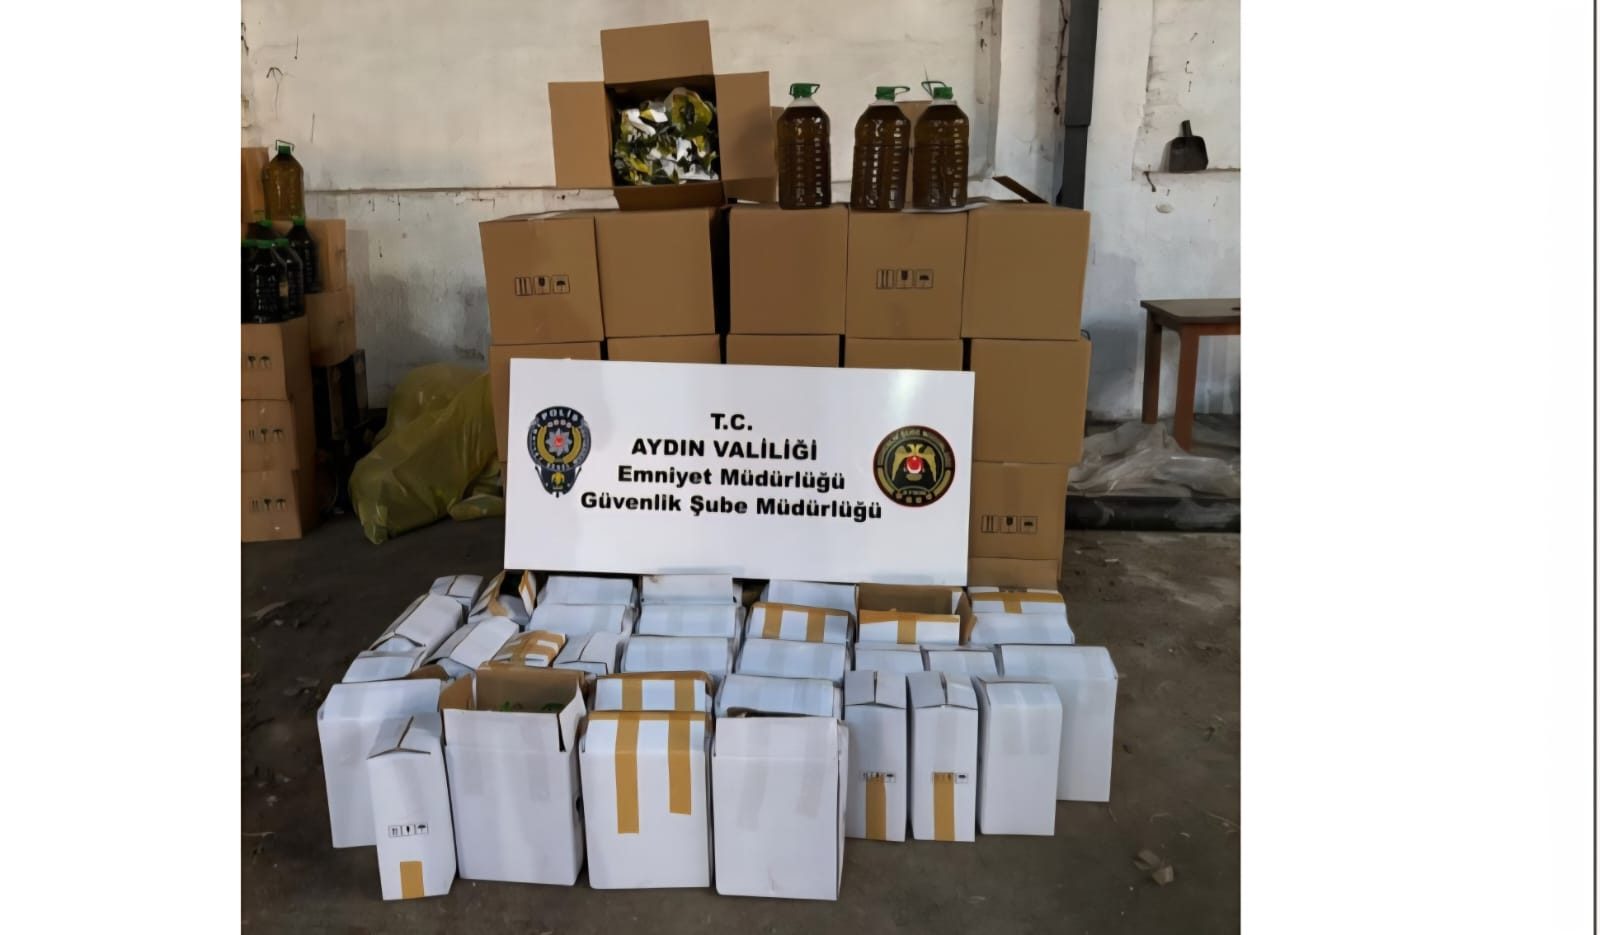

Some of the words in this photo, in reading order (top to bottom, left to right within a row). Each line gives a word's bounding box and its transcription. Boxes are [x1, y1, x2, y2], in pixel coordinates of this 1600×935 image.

[710, 412, 753, 431] T.C.
[631, 438, 705, 456] AYDIN
[713, 437, 817, 461] VALİLİĞİ
[618, 465, 712, 487] Emniyet
[720, 468, 845, 494] Müdürlüğü
[580, 491, 682, 512] Güvenlik
[690, 495, 748, 517] Şube
[756, 499, 882, 523] Müdürlüğü
